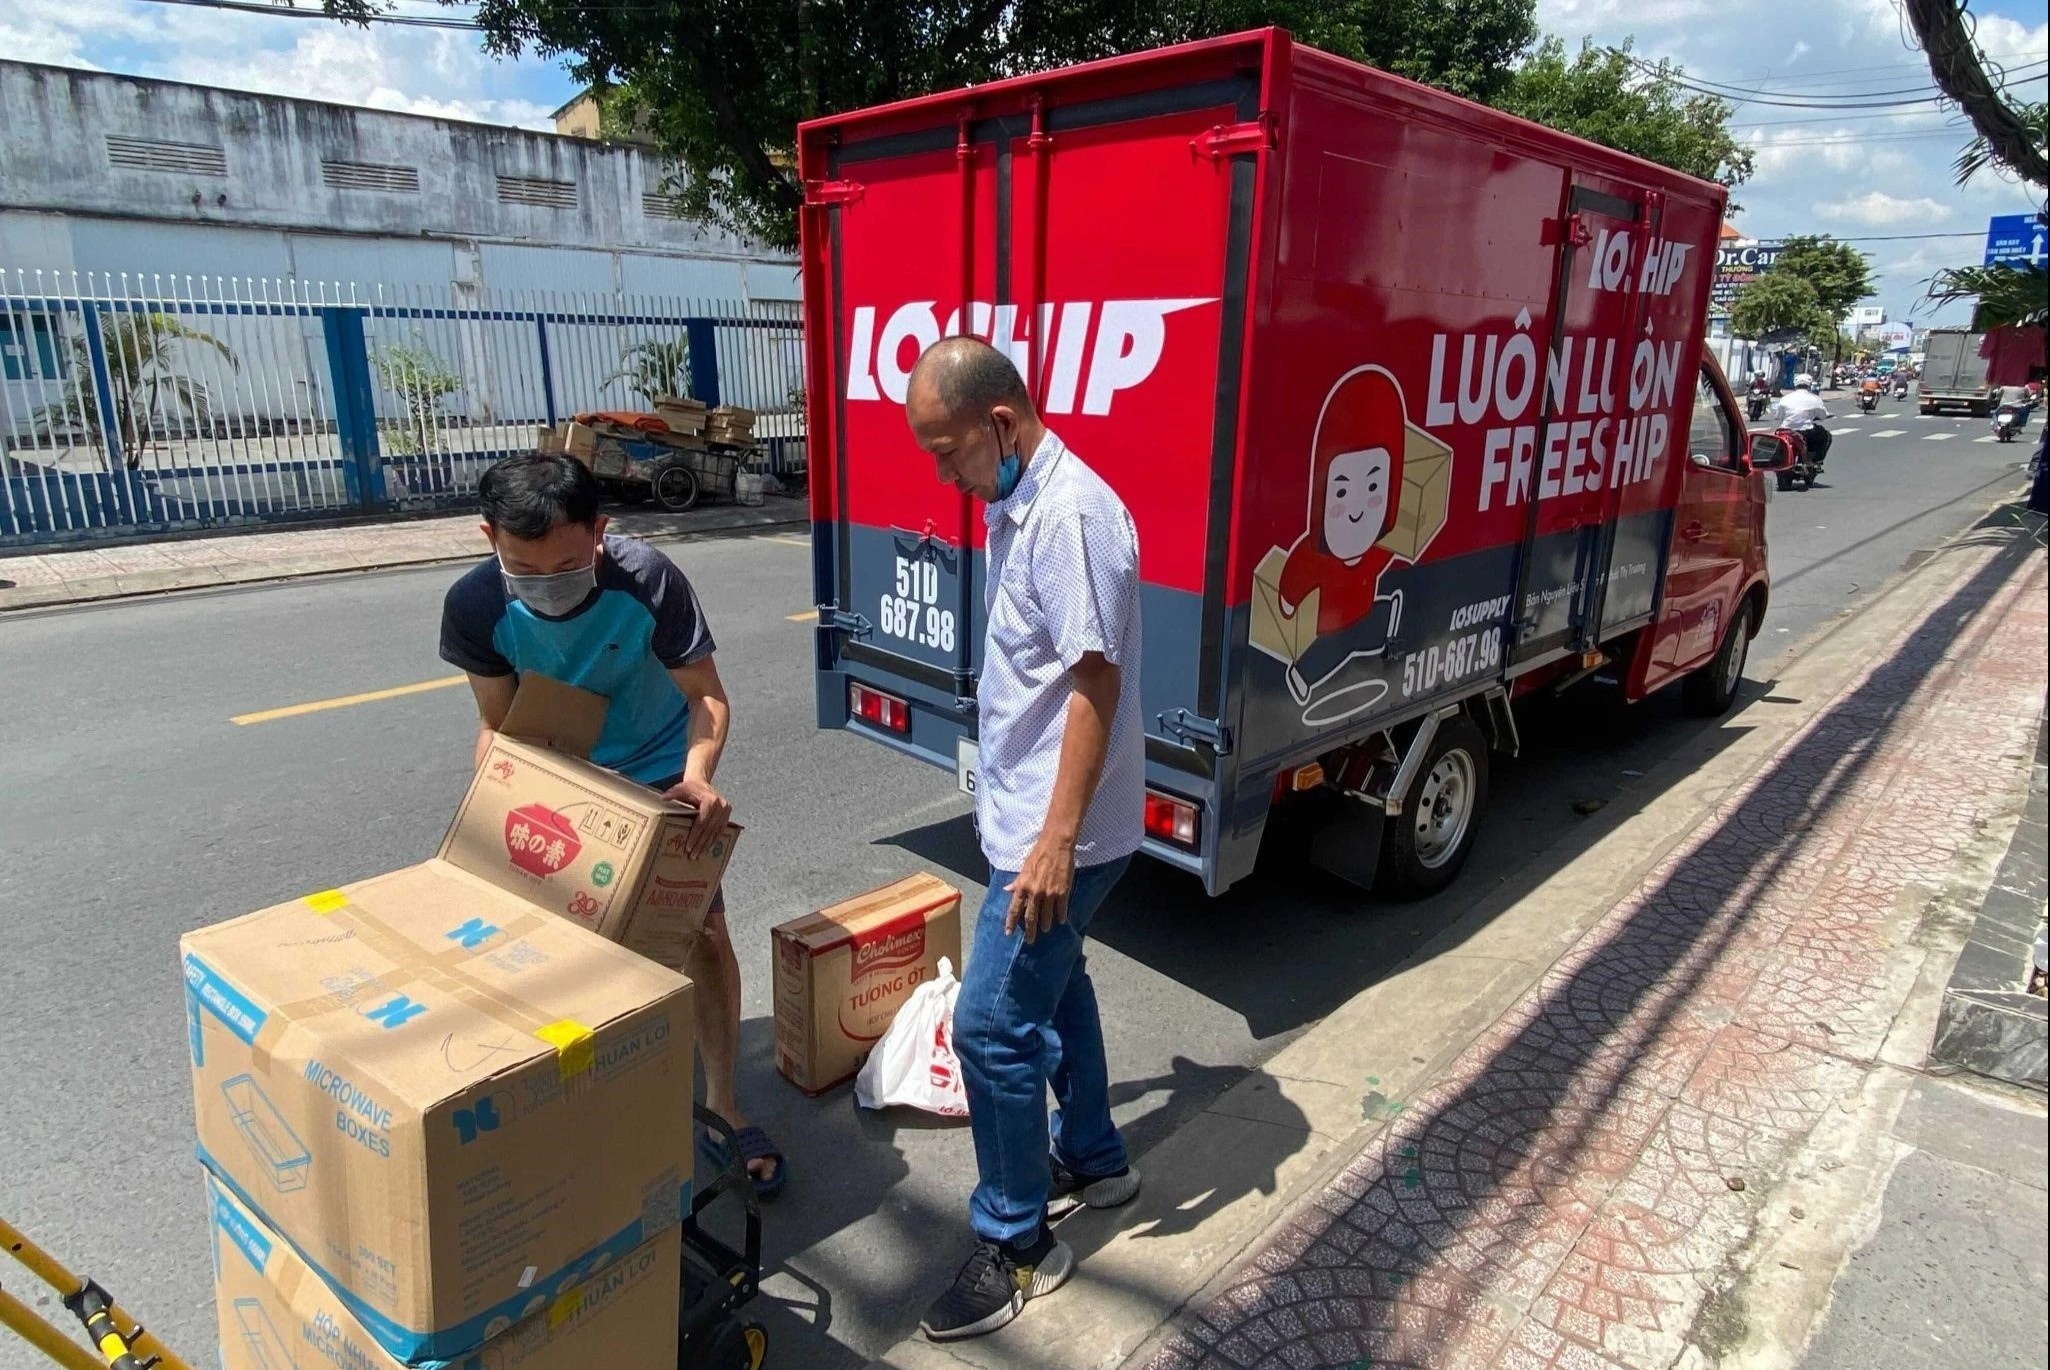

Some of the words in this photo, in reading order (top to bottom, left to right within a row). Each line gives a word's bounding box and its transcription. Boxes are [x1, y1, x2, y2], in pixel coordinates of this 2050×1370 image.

[1425, 306, 1573, 427] LUÔN
[1478, 413, 1668, 512] FREESHIP
[895, 556, 938, 605] 51D
[880, 594, 955, 653] 687.98
[1402, 626, 1501, 697] 51D-687.98
[857, 928, 921, 964] Cholimex
[849, 977, 903, 1011] TƯƠNG
[304, 1058, 392, 1133] MICROWAVE
[336, 1110, 389, 1157] BOXES
